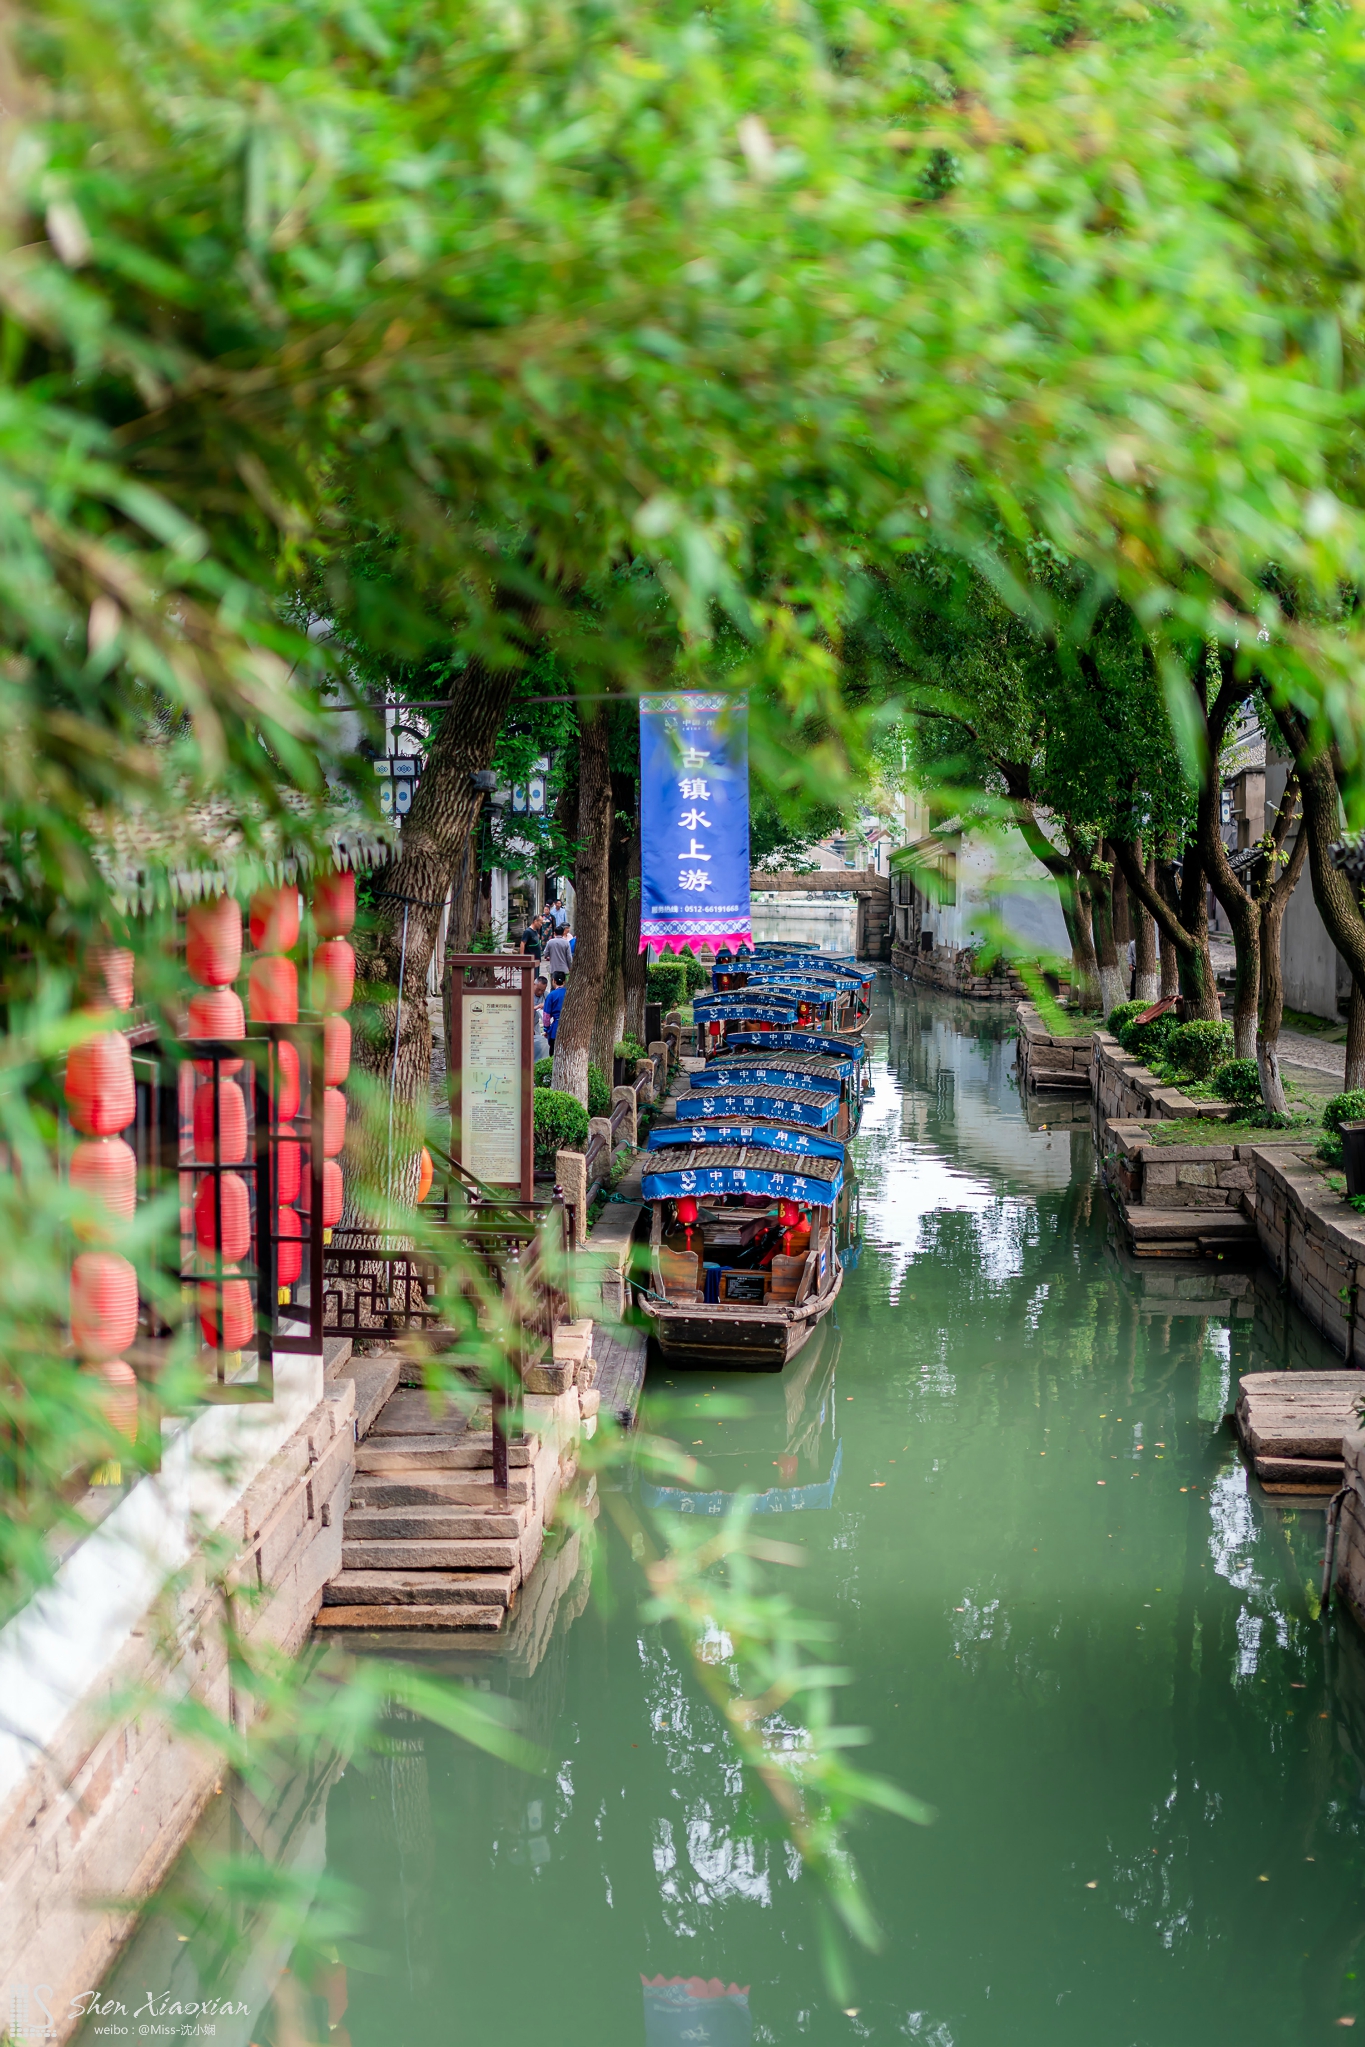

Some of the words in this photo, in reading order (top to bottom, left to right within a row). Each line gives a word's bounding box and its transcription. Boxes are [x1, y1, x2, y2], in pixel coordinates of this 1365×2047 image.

[677, 747, 712, 892] 古镇水上游
[772, 1140, 808, 1152] LUZHI
[767, 1184, 806, 1195] LUZHI
